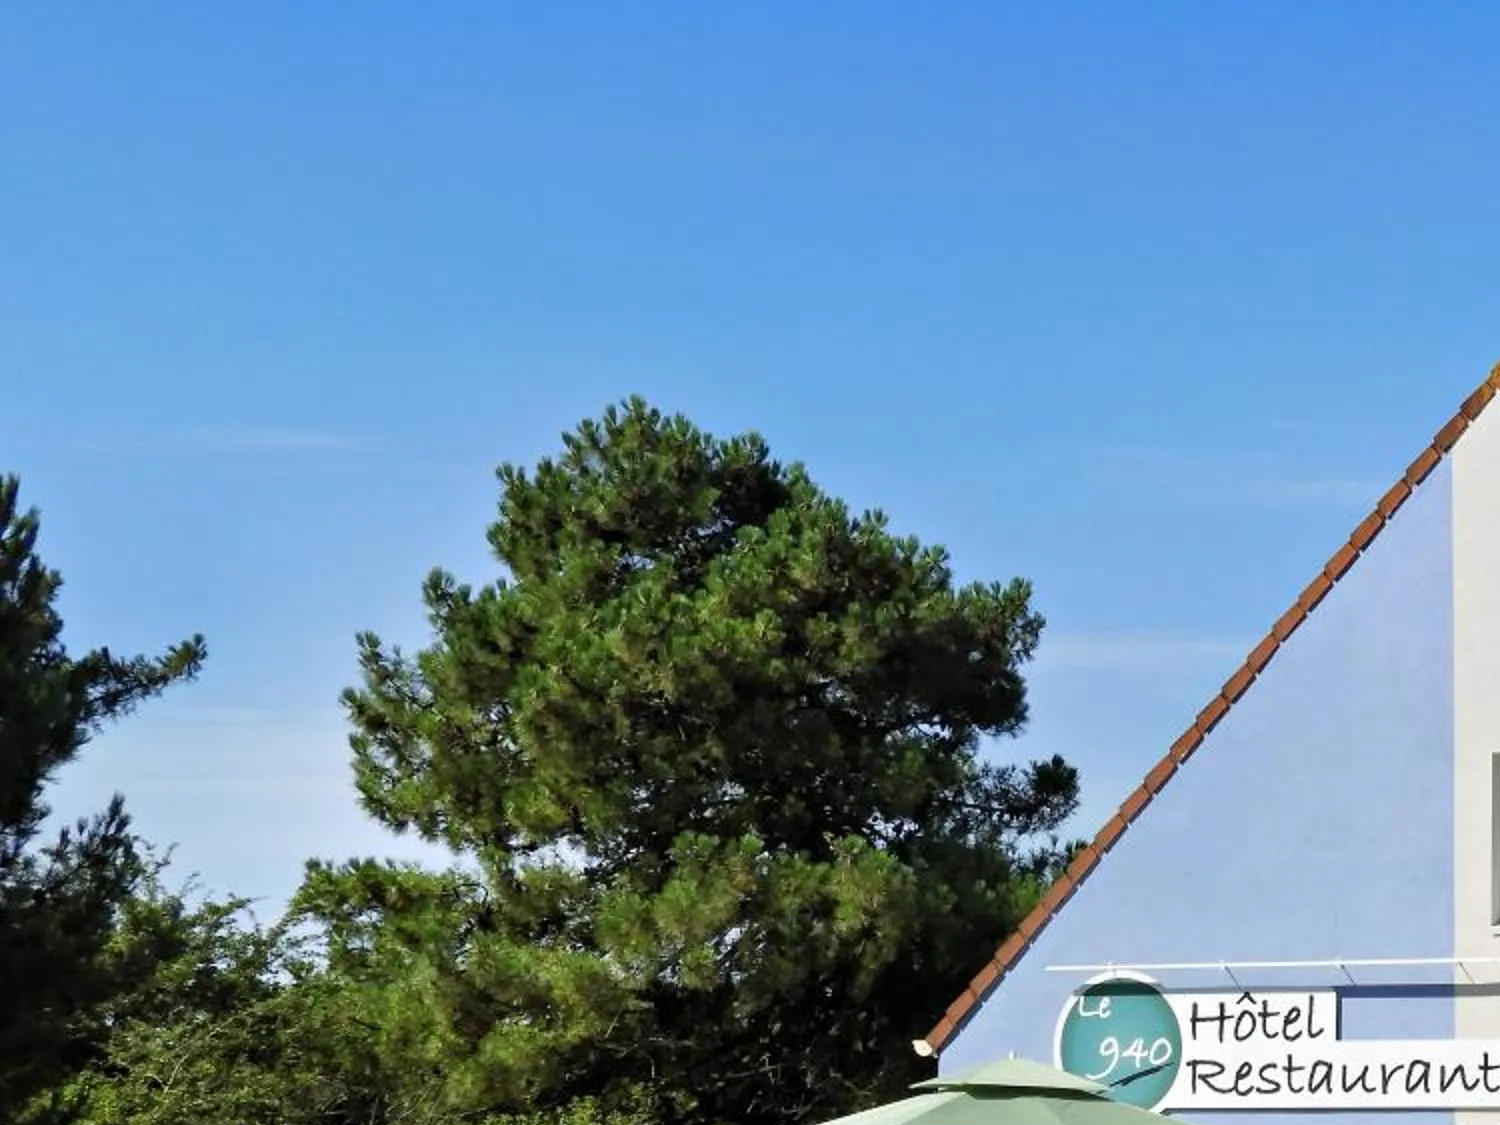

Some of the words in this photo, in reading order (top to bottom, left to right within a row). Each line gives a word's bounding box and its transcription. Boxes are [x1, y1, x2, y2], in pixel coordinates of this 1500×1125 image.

[1079, 996, 1112, 1018] Le
[1190, 991, 1324, 1043] Hôtel
[1085, 1036, 1172, 1080] 940
